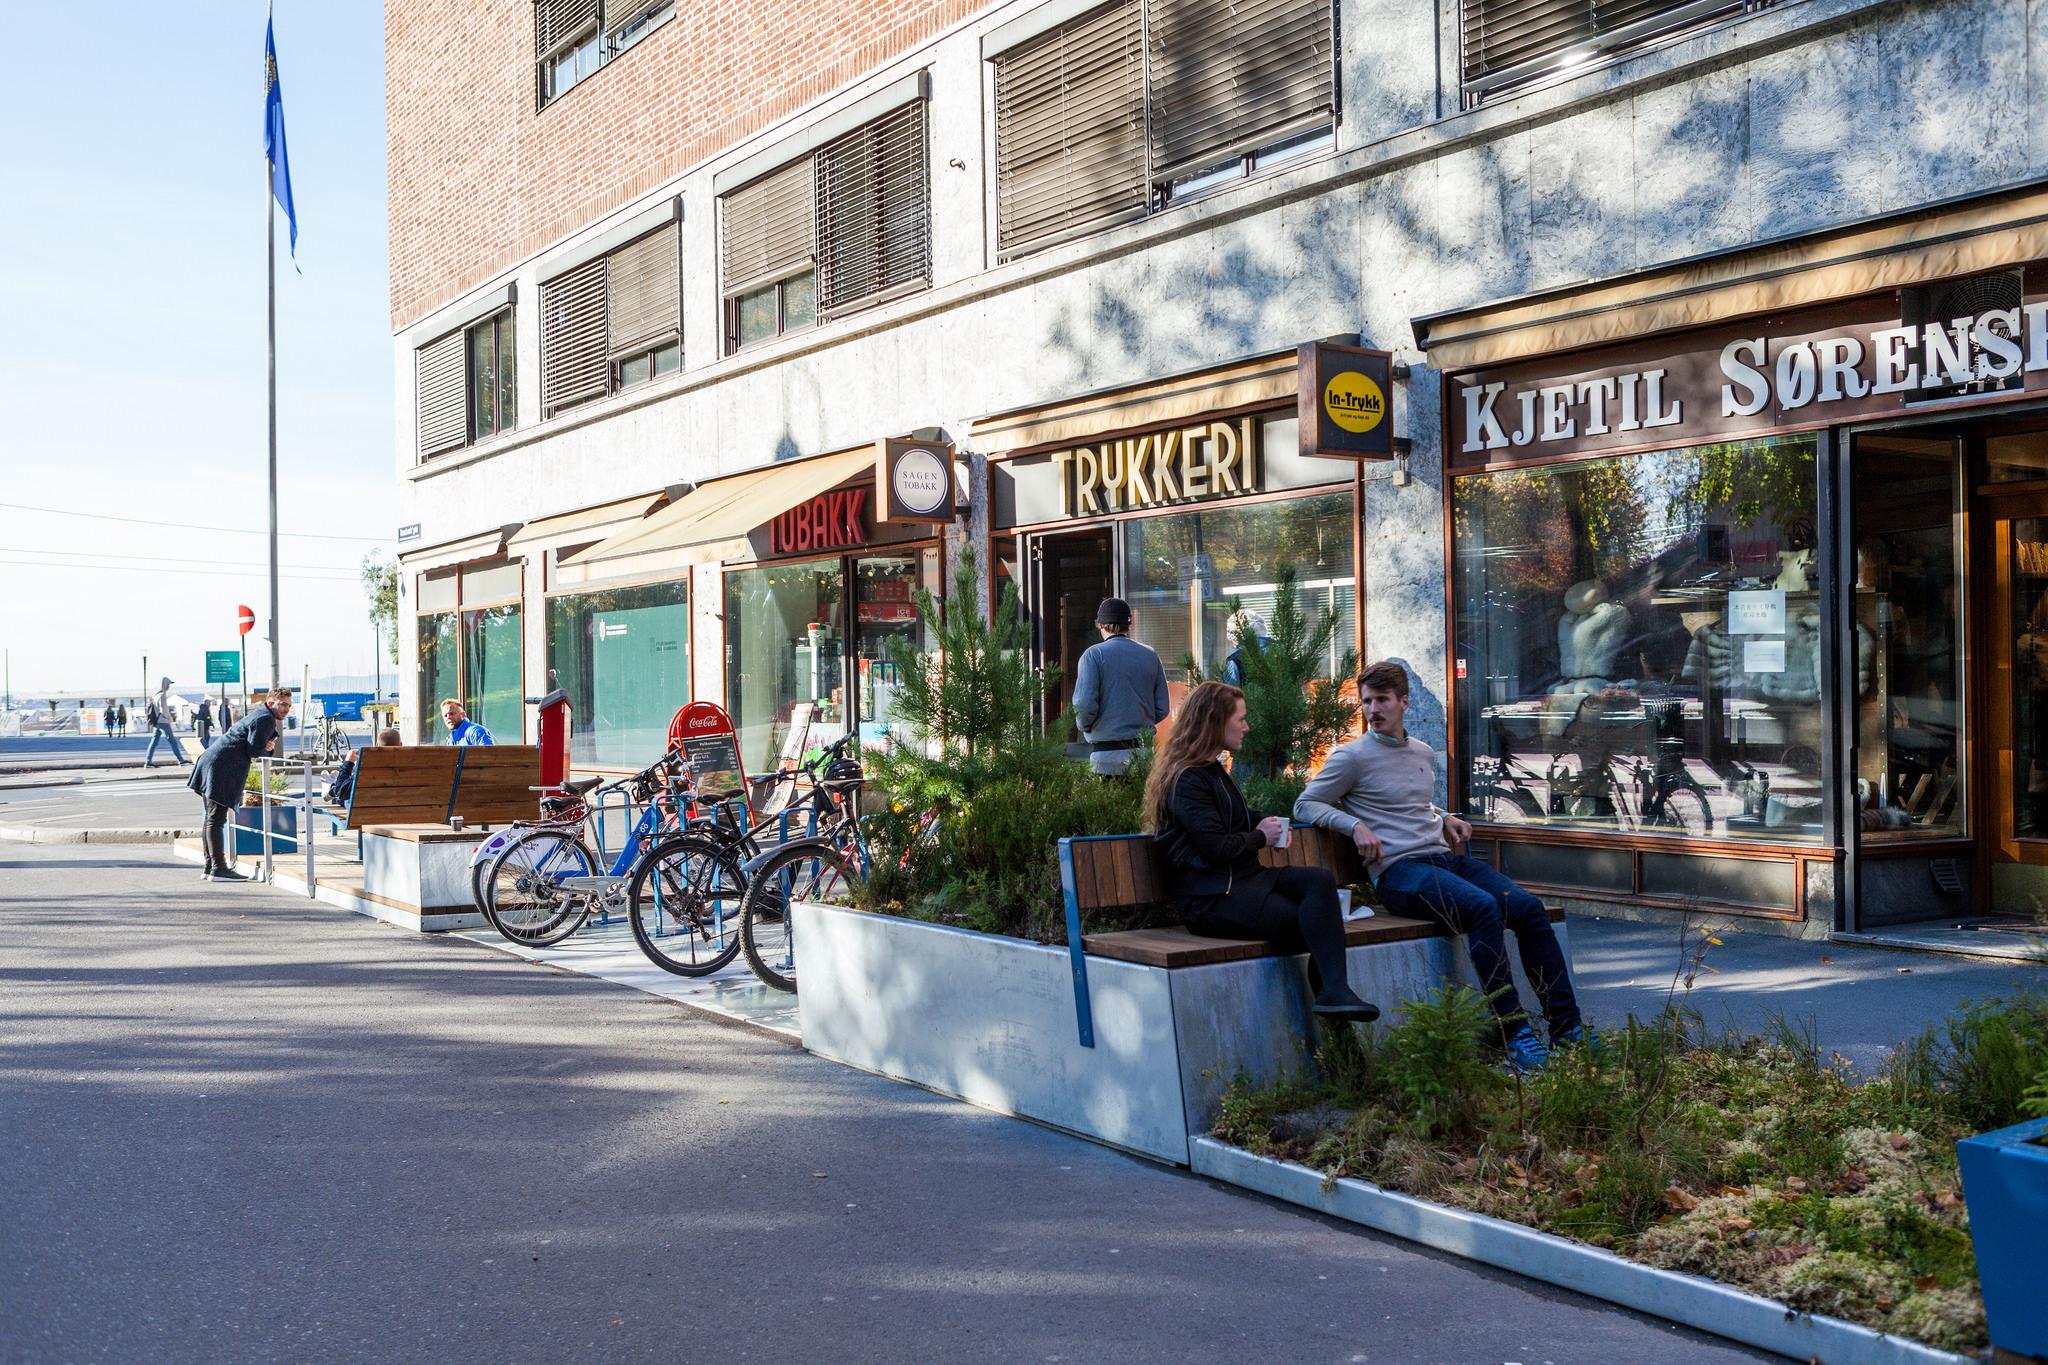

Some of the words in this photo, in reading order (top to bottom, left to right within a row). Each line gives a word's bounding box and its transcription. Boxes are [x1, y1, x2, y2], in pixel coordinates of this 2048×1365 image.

[1329, 390, 1380, 412] In-Trykk
[1462, 368, 1682, 453] KJETIL
[902, 471, 937, 480] SAGEN
[1052, 416, 1257, 516] TRYKKERI
[904, 481, 937, 490] TOBAKK
